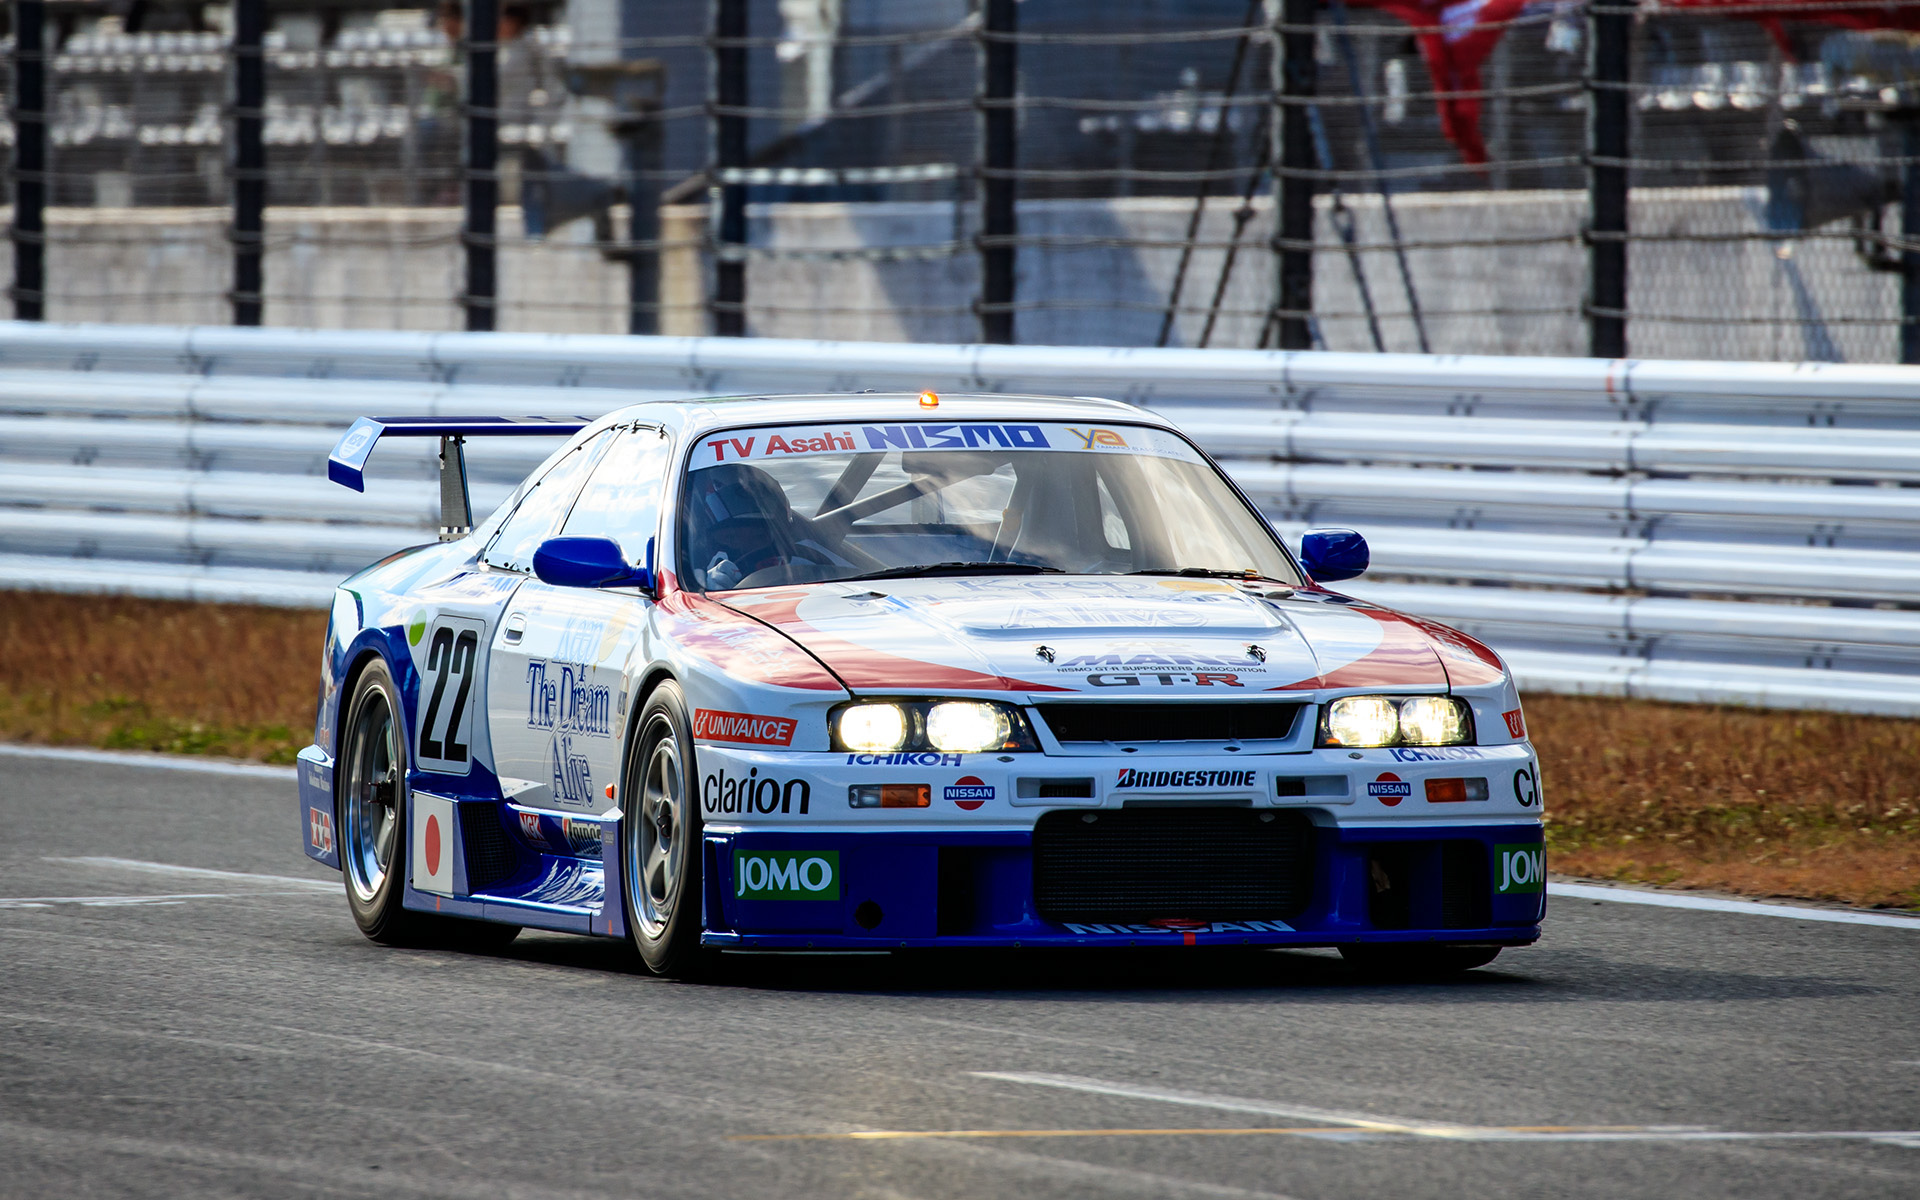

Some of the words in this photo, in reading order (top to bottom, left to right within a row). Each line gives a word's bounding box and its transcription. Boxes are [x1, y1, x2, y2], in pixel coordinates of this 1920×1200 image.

[707, 436, 756, 462] TV
[765, 431, 857, 456] Asahi
[861, 425, 1052, 450] NISMO
[1086, 672, 1245, 688] GT-R
[419, 625, 478, 763] 22
[526, 659, 556, 732] The
[552, 661, 611, 739] Dream
[707, 715, 791, 741] UNIVANCE
[846, 753, 963, 767] ICHIKOH
[1389, 747, 1487, 763] ICHIKOH
[553, 732, 594, 808] Alive
[1114, 767, 1256, 788] BRIDGESTONE
[703, 766, 811, 815] clarion
[945, 787, 994, 799] NISSAN
[1369, 784, 1410, 794] NISSAN
[520, 815, 547, 842] NGK
[737, 856, 833, 897] JOMO
[1499, 849, 1544, 892] JOM
